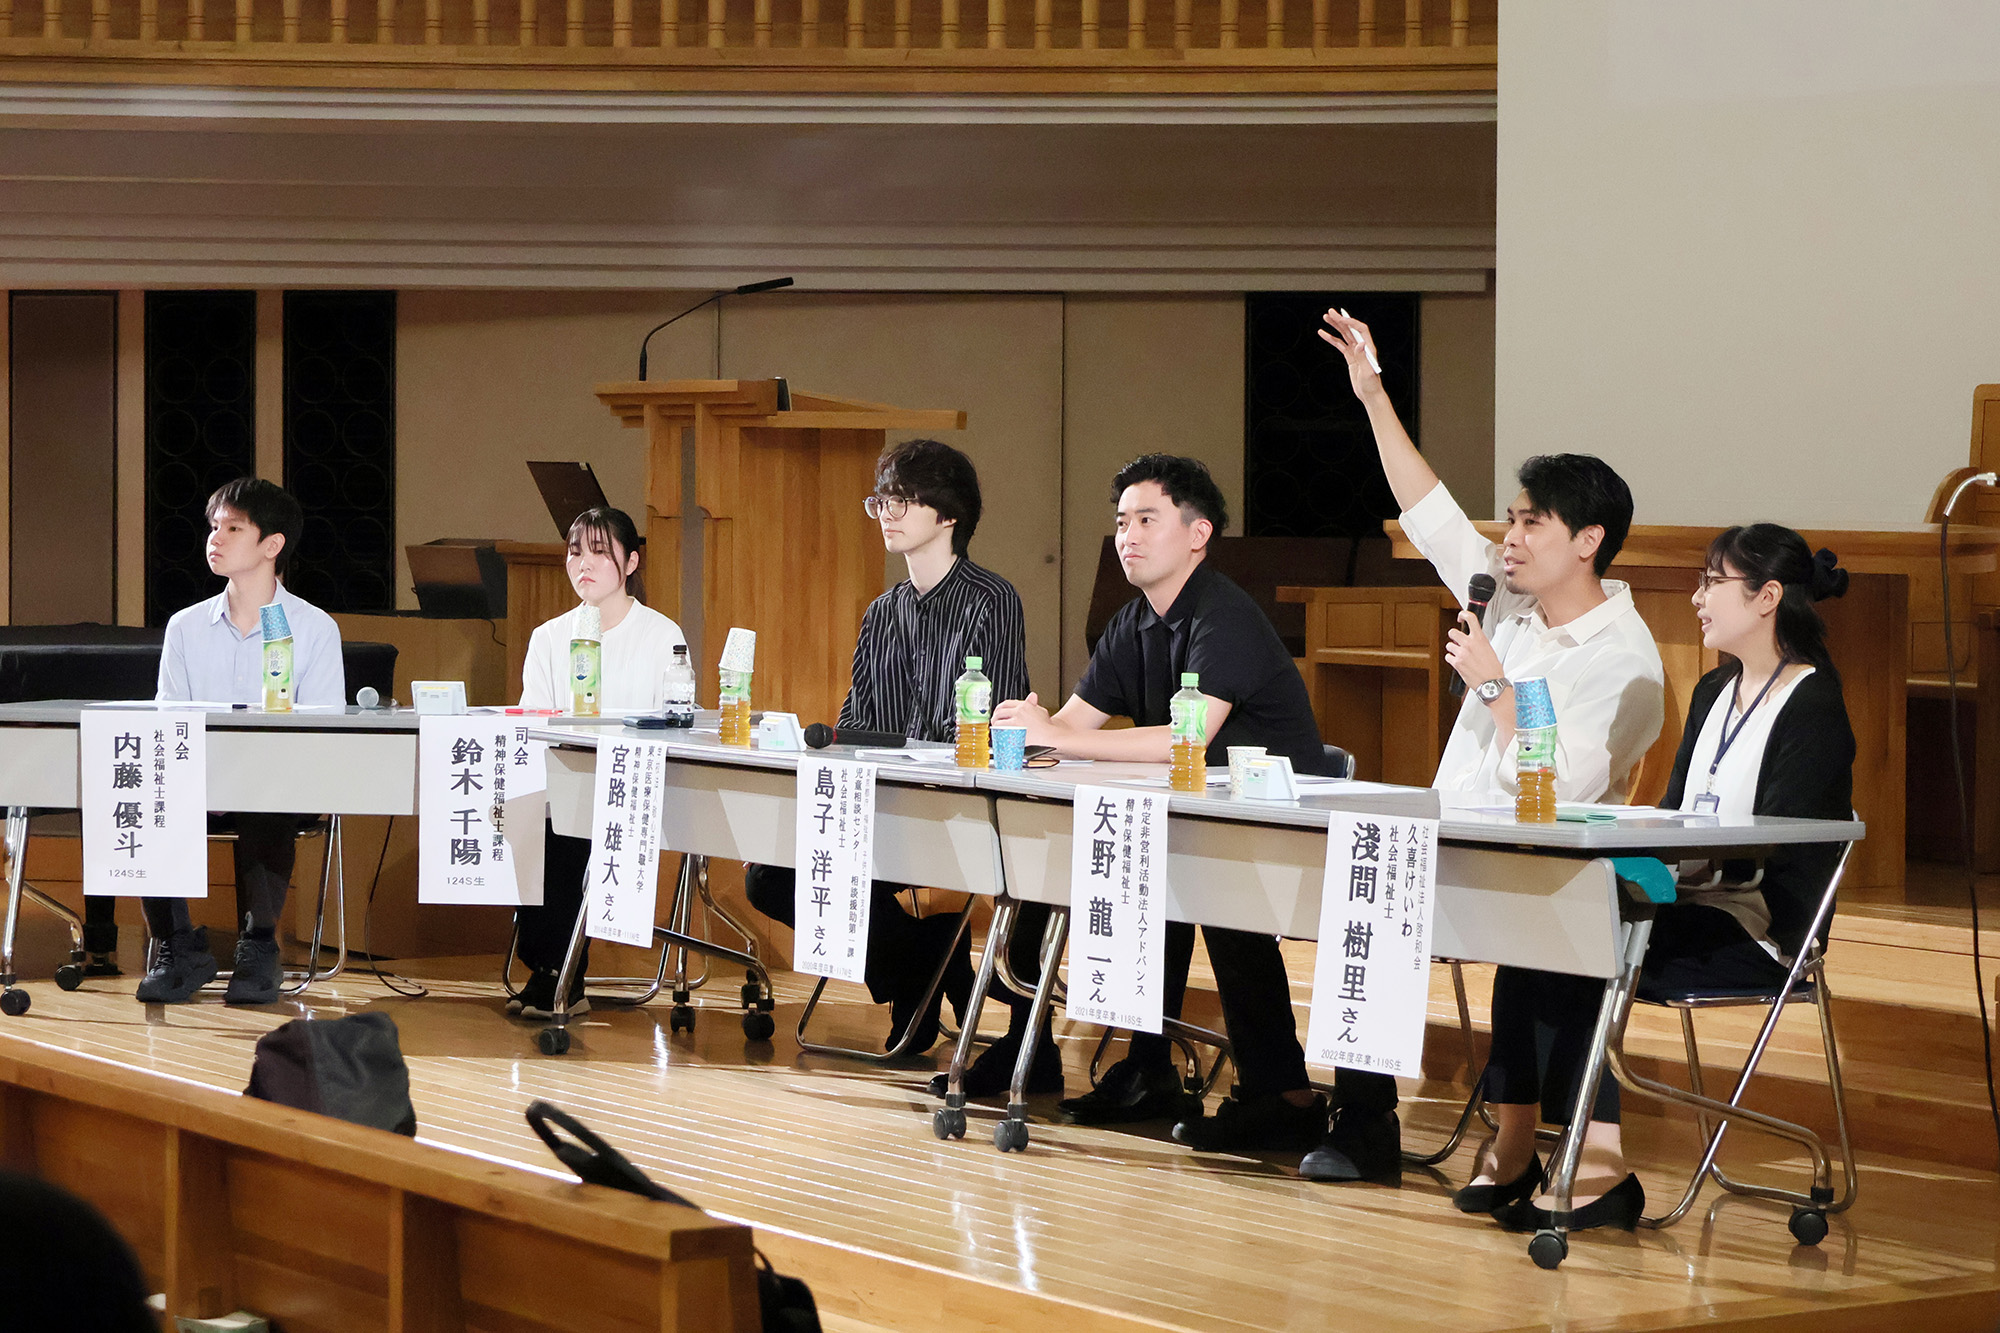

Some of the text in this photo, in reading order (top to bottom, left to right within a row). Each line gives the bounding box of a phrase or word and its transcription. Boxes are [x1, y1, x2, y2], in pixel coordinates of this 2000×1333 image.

[154, 729, 165, 828] 社会福祉士課程
[175, 722, 189, 760] 司会
[514, 727, 529, 766] 司会
[607, 744, 630, 809] 宮路
[113, 732, 143, 858] 内藤 優斗
[450, 737, 484, 865] 鈴木 千陽
[492, 734, 506, 862] 精神保健福祉士課程
[628, 747, 641, 838] 精神保健福祉士
[813, 766, 835, 835] 島子
[838, 768, 848, 848] 社会福祉士
[1091, 796, 1118, 879] 矢野
[109, 869, 147, 878] 124S生
[447, 876, 485, 886] 124S生
[847, 768, 863, 958] 児童相談センター 相談援助第一課
[1121, 798, 1135, 905] 精神保健福祉士
[1135, 797, 1152, 997] 特定非営利活動法人アドバンス
[1349, 822, 1380, 904] 淺間
[1384, 825, 1400, 919] 社会福祉士
[1401, 824, 1419, 938] 久喜けいわ
